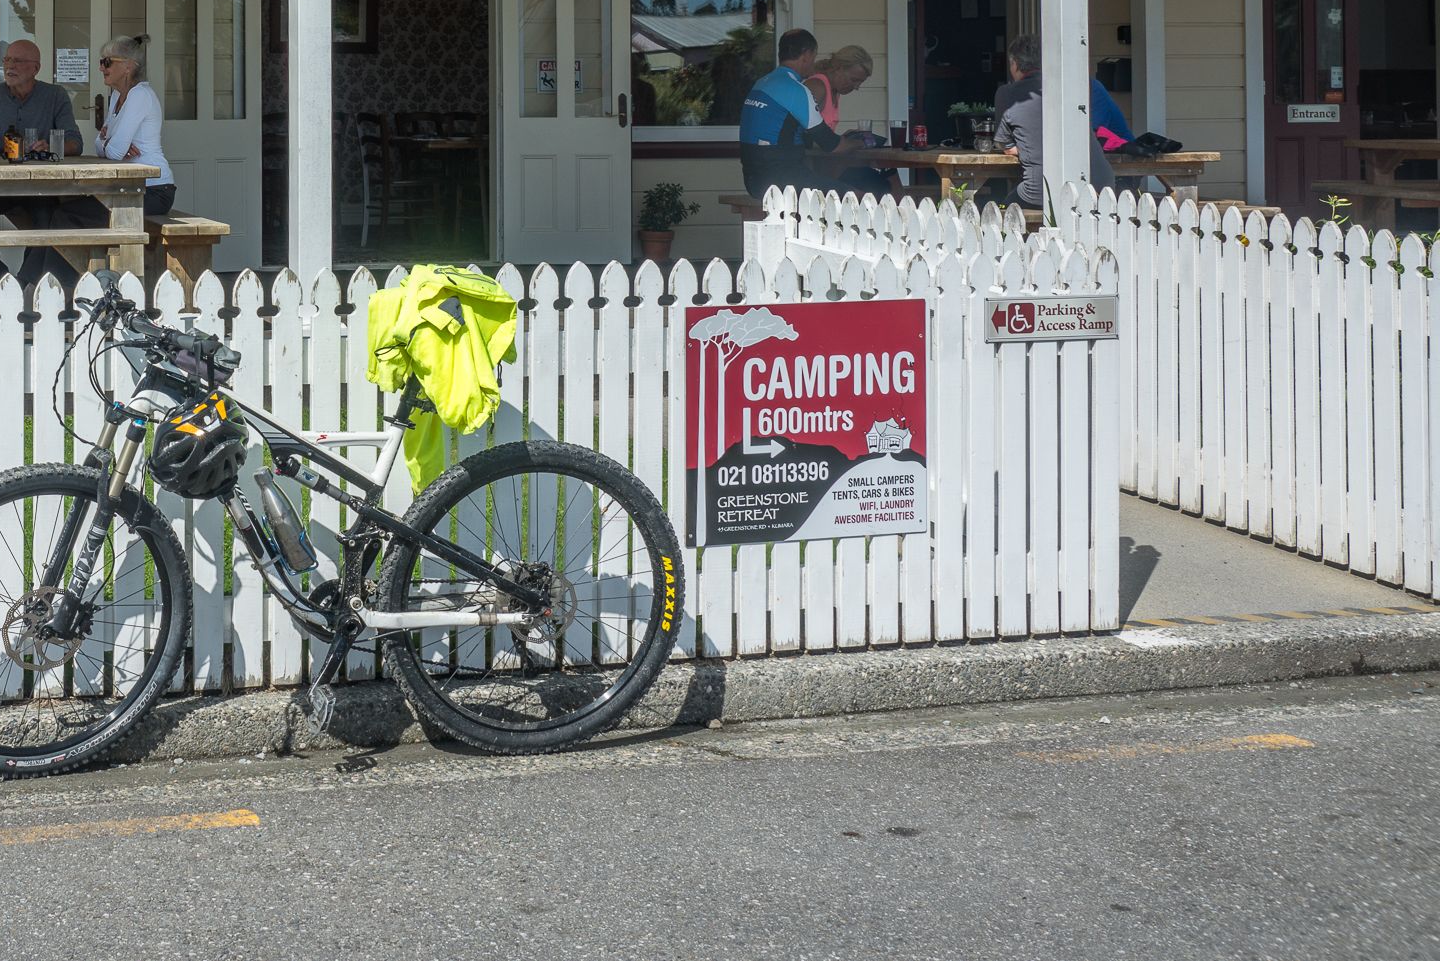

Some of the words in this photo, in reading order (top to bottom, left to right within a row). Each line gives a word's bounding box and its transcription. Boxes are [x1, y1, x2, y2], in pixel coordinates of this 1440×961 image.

[744, 99, 768, 108] GIANT
[1292, 108, 1336, 118] Entrance
[1037, 304, 1084, 320] Parking
[1085, 303, 1096, 315] &
[1037, 319, 1076, 331] Access
[1079, 319, 1113, 332] Ramp
[743, 351, 915, 401] CAMPING
[758, 406, 854, 435] 600mtrs
[718, 466, 746, 486] 021
[751, 461, 829, 484] 08113396
[848, 477, 875, 487] SMALL
[877, 475, 914, 485] CAMPERS
[717, 492, 809, 508] GREENSTONE
[832, 490, 860, 500] TENTS,
[861, 489, 881, 499] CARS
[884, 488, 890, 497] &
[892, 487, 914, 497] BIKES
[859, 502, 878, 511] WIFI,
[880, 499, 914, 510] LAUNDRY
[718, 508, 780, 523] RETREAT
[834, 513, 872, 524] AWESOME
[874, 511, 914, 522] FACILITIES
[724, 524, 758, 532] GREENSTONE
[68, 538, 101, 598] FOX
[661, 556, 675, 632] MAXXIS
